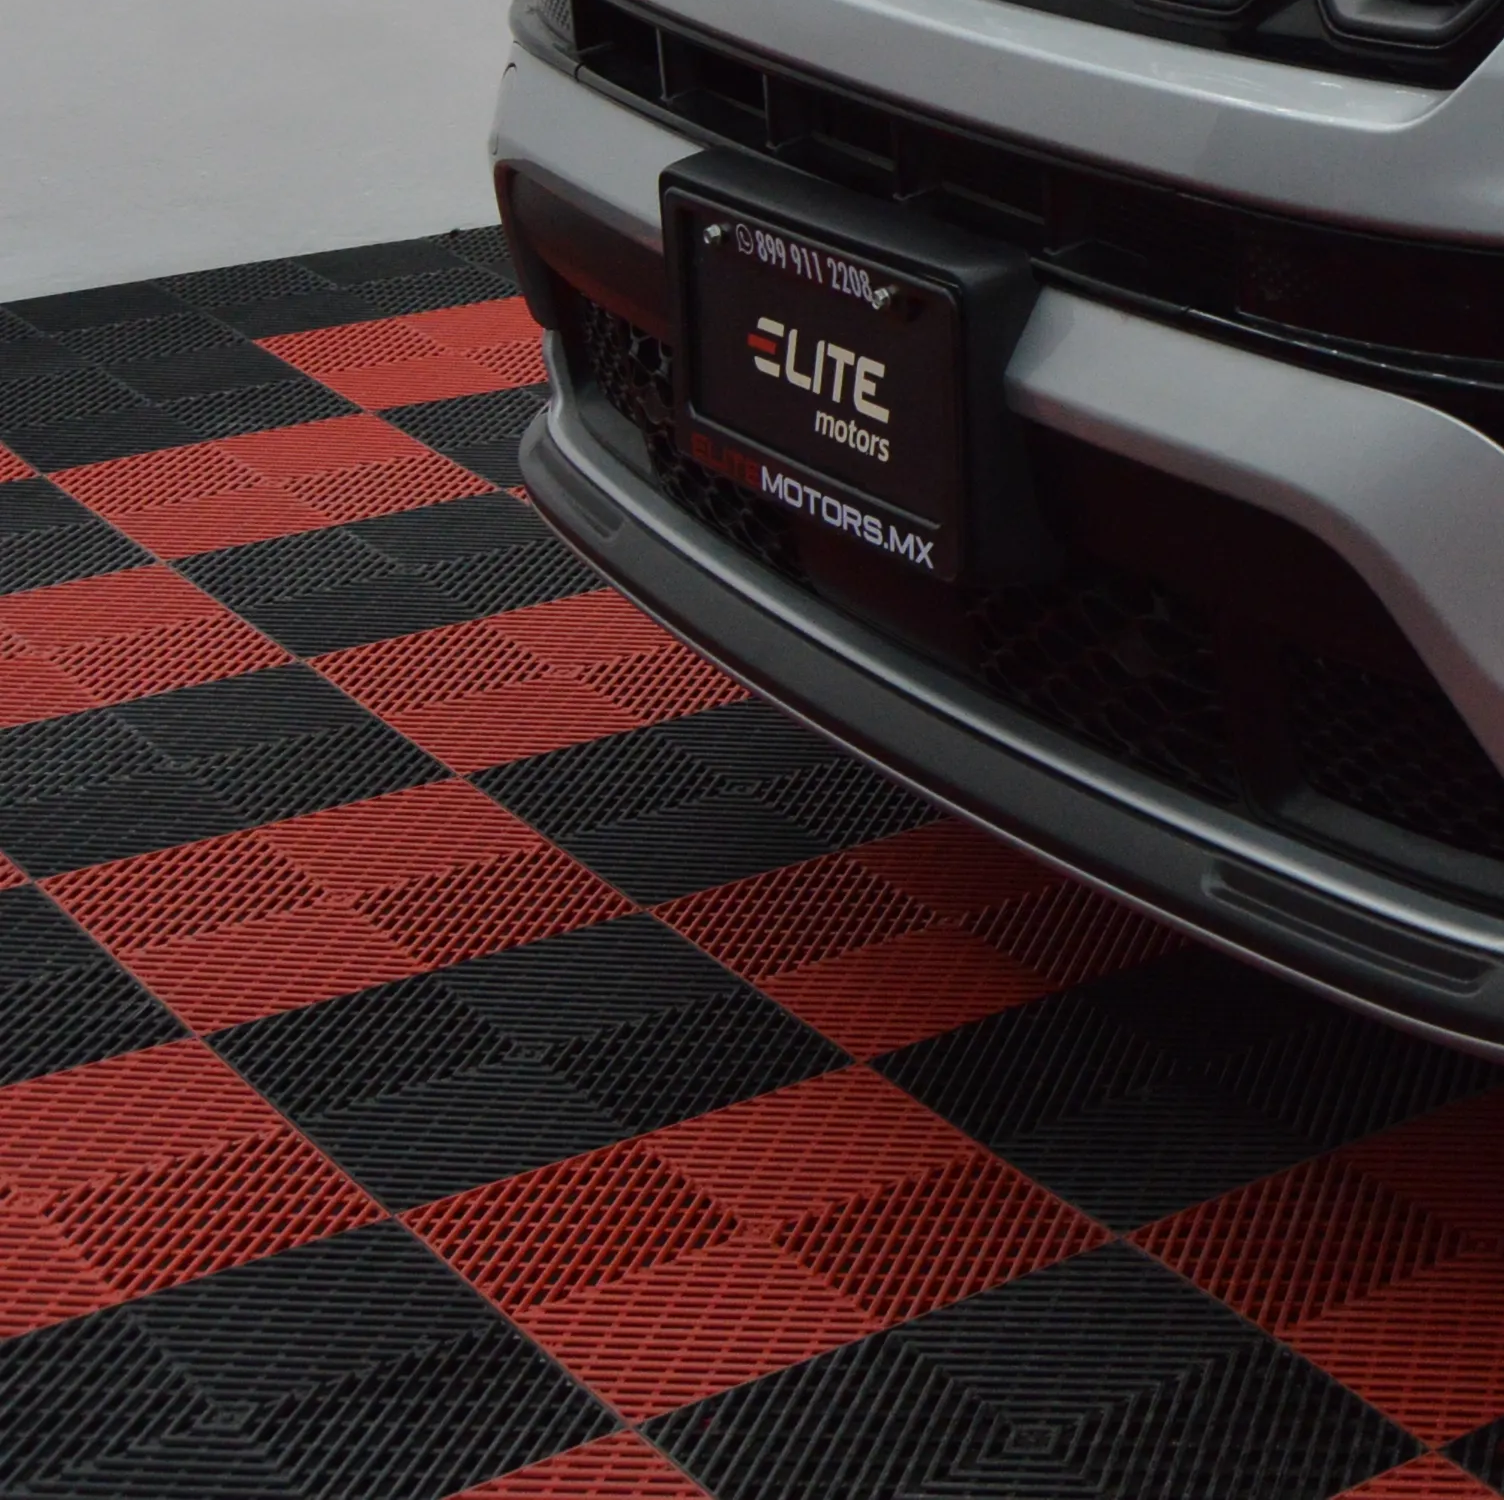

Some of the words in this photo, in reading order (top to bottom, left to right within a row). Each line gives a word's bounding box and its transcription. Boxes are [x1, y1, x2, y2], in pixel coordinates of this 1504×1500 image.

[755, 229, 786, 269] 899
[789, 243, 823, 285] 911
[826, 256, 873, 303] 2208
[747, 316, 890, 423] ELITE
[814, 409, 890, 463] motors
